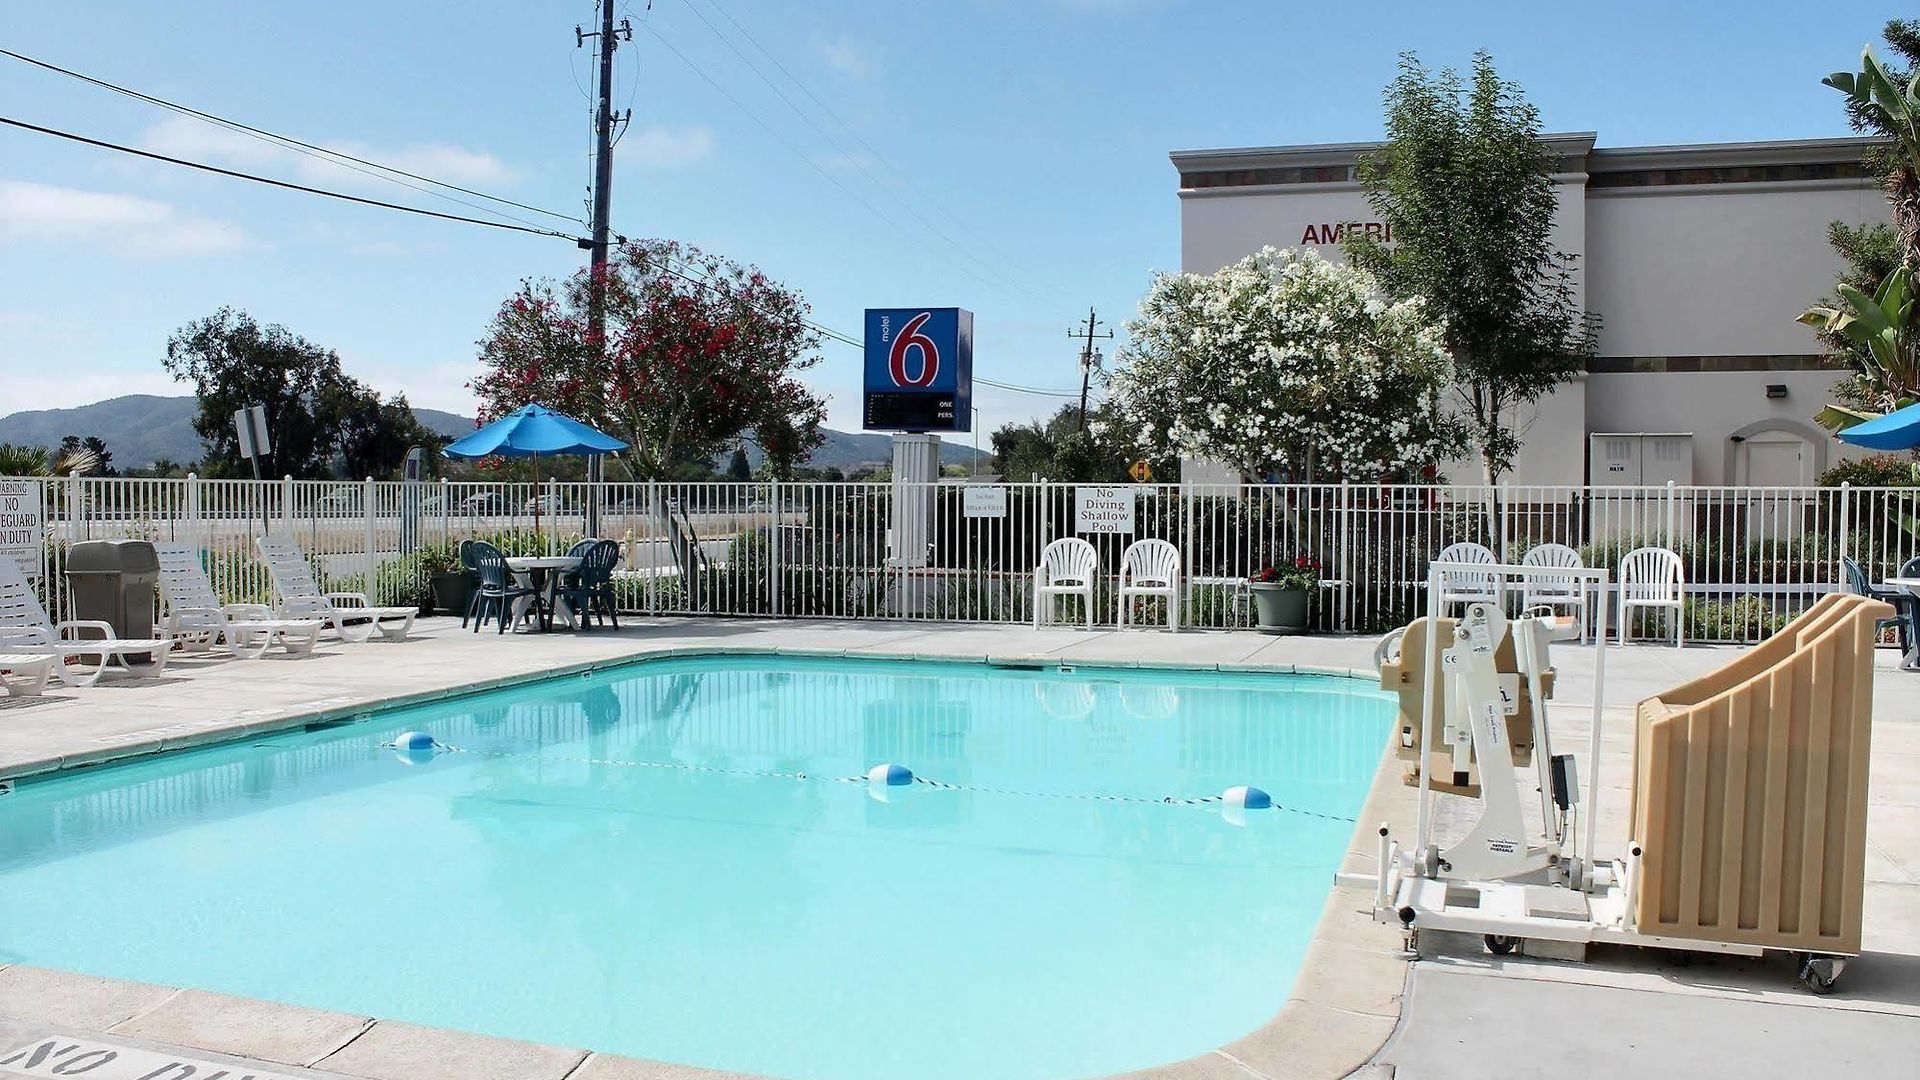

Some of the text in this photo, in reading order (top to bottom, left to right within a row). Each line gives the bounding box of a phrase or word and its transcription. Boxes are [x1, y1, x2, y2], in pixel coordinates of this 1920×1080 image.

[881, 316, 890, 342] motel
[888, 311, 940, 388] 6
[0, 483, 27, 494] ARNING
[1096, 489, 1114, 498] No
[5, 497, 19, 511] NO
[1086, 499, 1126, 511] Diving
[0, 513, 37, 528] EGUARD
[1080, 510, 1129, 521] Shallow
[1092, 522, 1119, 532] Pool
[9, 530, 33, 544] DUTY
[0, 1041, 118, 1075] NO
